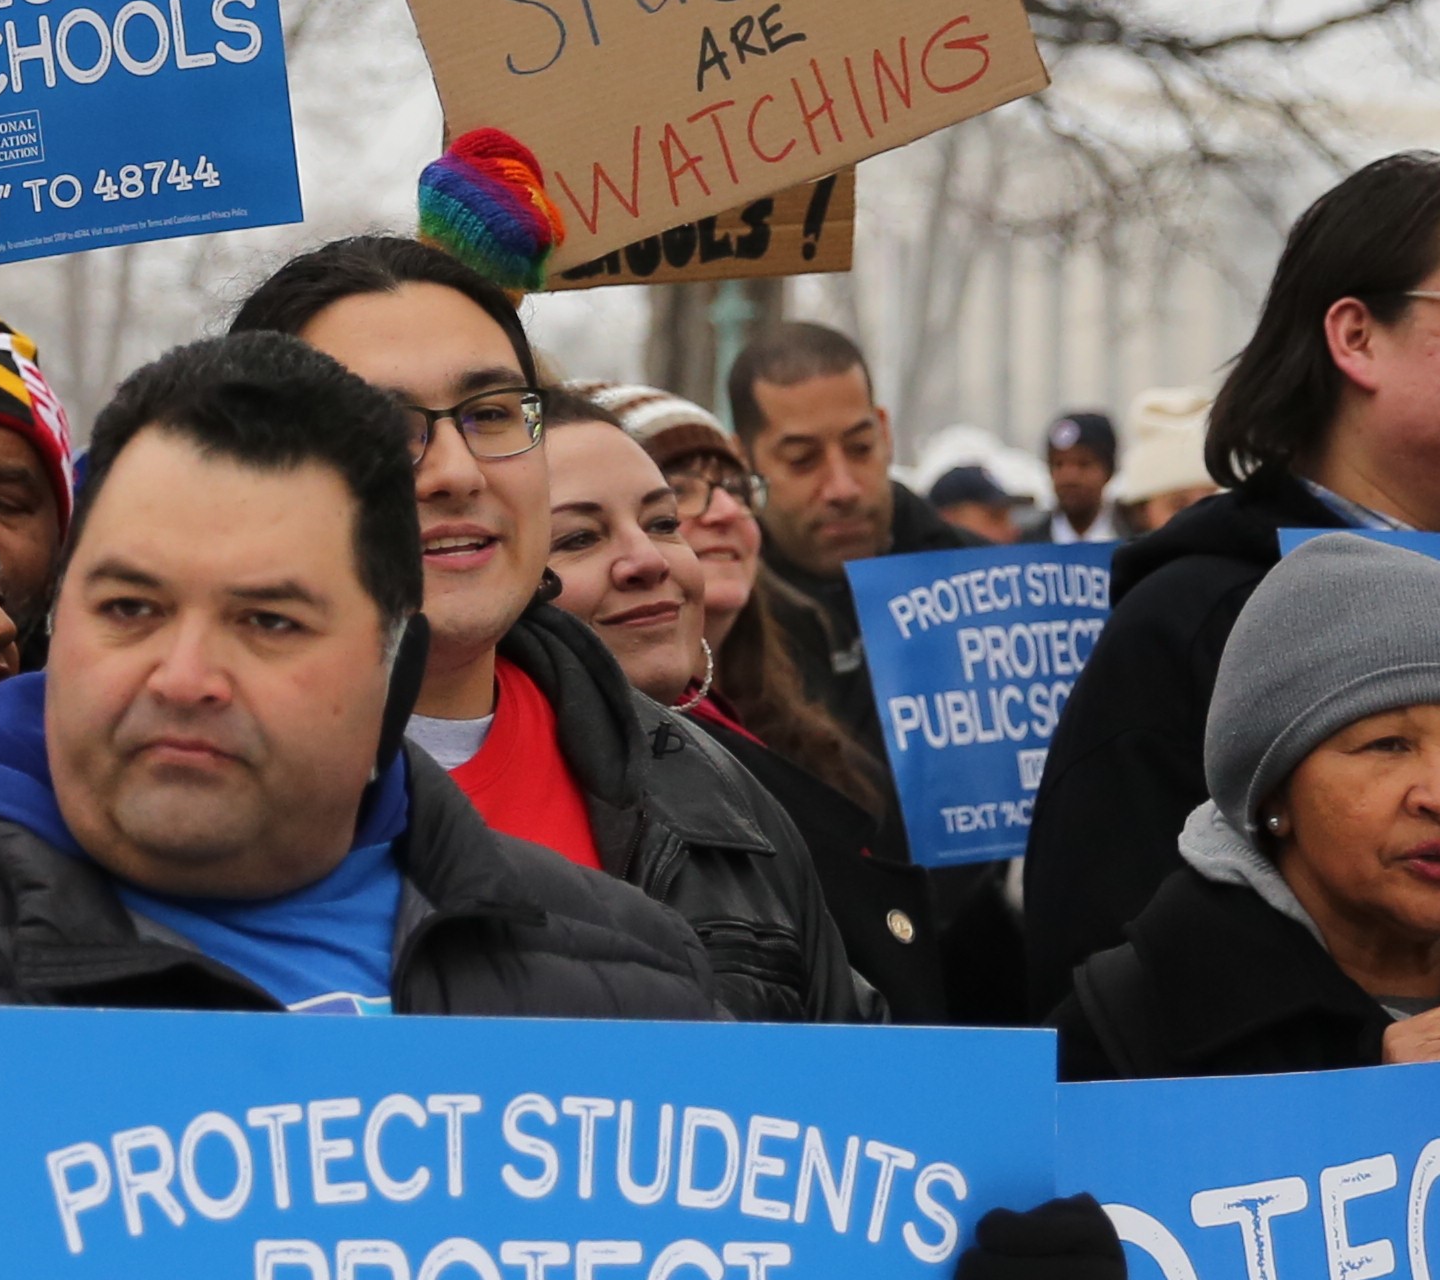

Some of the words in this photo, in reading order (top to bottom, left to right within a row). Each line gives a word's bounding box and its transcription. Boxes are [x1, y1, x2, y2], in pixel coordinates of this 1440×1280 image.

[696, 4, 806, 92] ARE
[554, 15, 990, 236] WATCHING
[23, 173, 83, 214] TO
[93, 156, 220, 201] 48744
[887, 564, 1021, 639] PROTECT
[1024, 563, 1111, 610] STUDE
[888, 684, 1028, 752] PUBLIC
[940, 802, 997, 834] TEXT
[46, 1094, 481, 1254] PROTECT
[500, 1093, 969, 1266] STUDENTS
